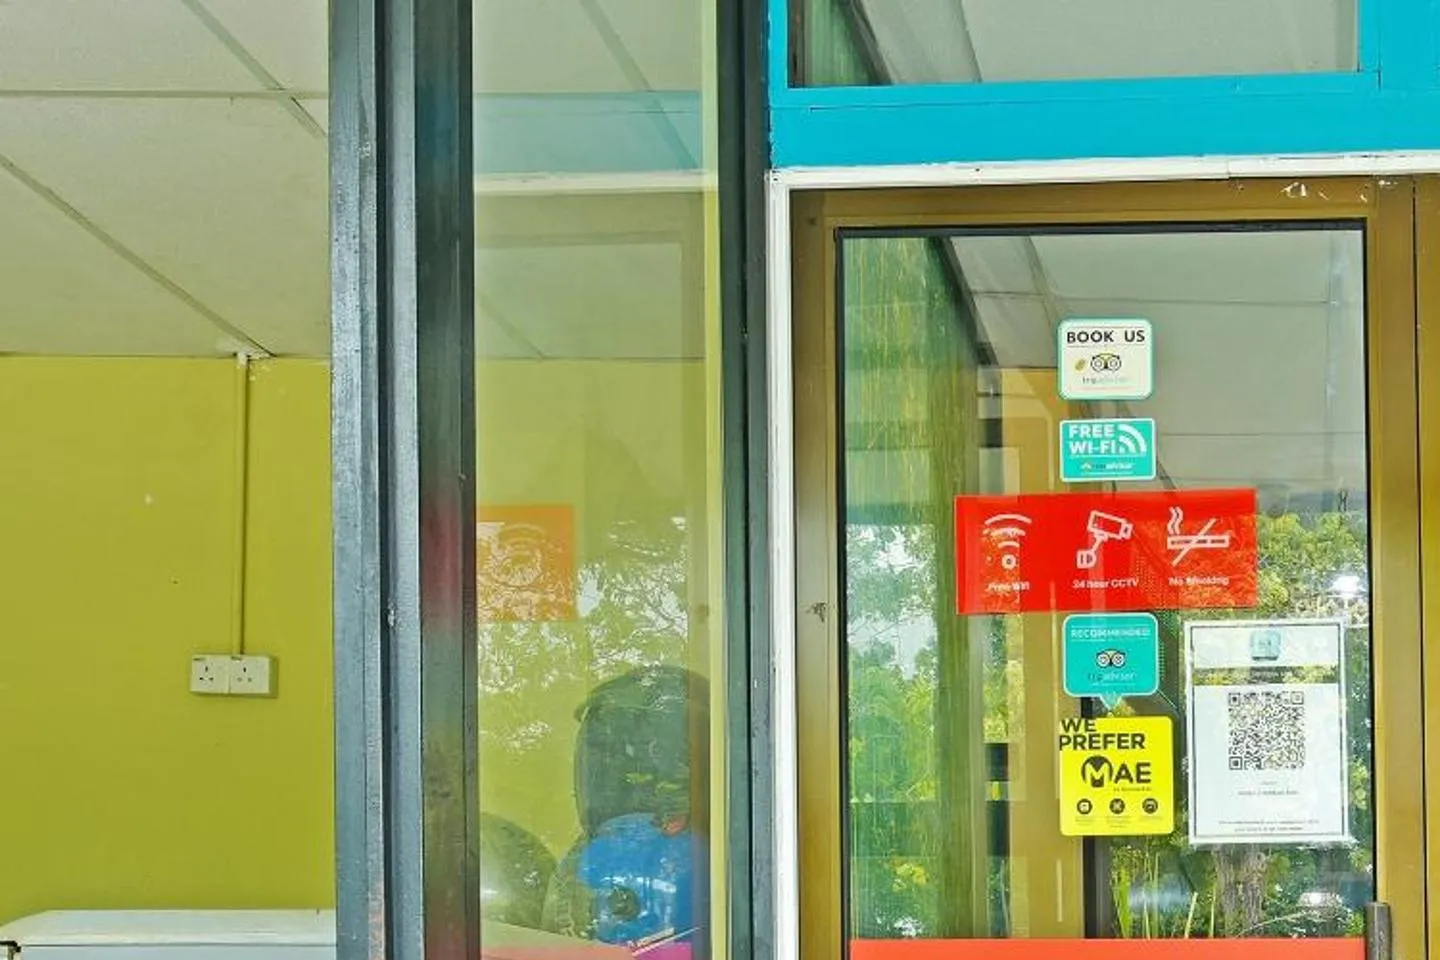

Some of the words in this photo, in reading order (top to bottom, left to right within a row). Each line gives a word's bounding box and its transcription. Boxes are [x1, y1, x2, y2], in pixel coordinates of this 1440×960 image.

[1066, 330, 1114, 343] BOOK
[1124, 329, 1145, 343] US
[1069, 423, 1115, 438] FREE
[1069, 439, 1117, 455] WI-FI
[1111, 577, 1140, 588] CCTV
[1071, 627, 1150, 639] RECOMMENDED
[1061, 719, 1097, 733] WE
[1059, 733, 1146, 751] PREFER
[1081, 755, 1152, 789] MAE
